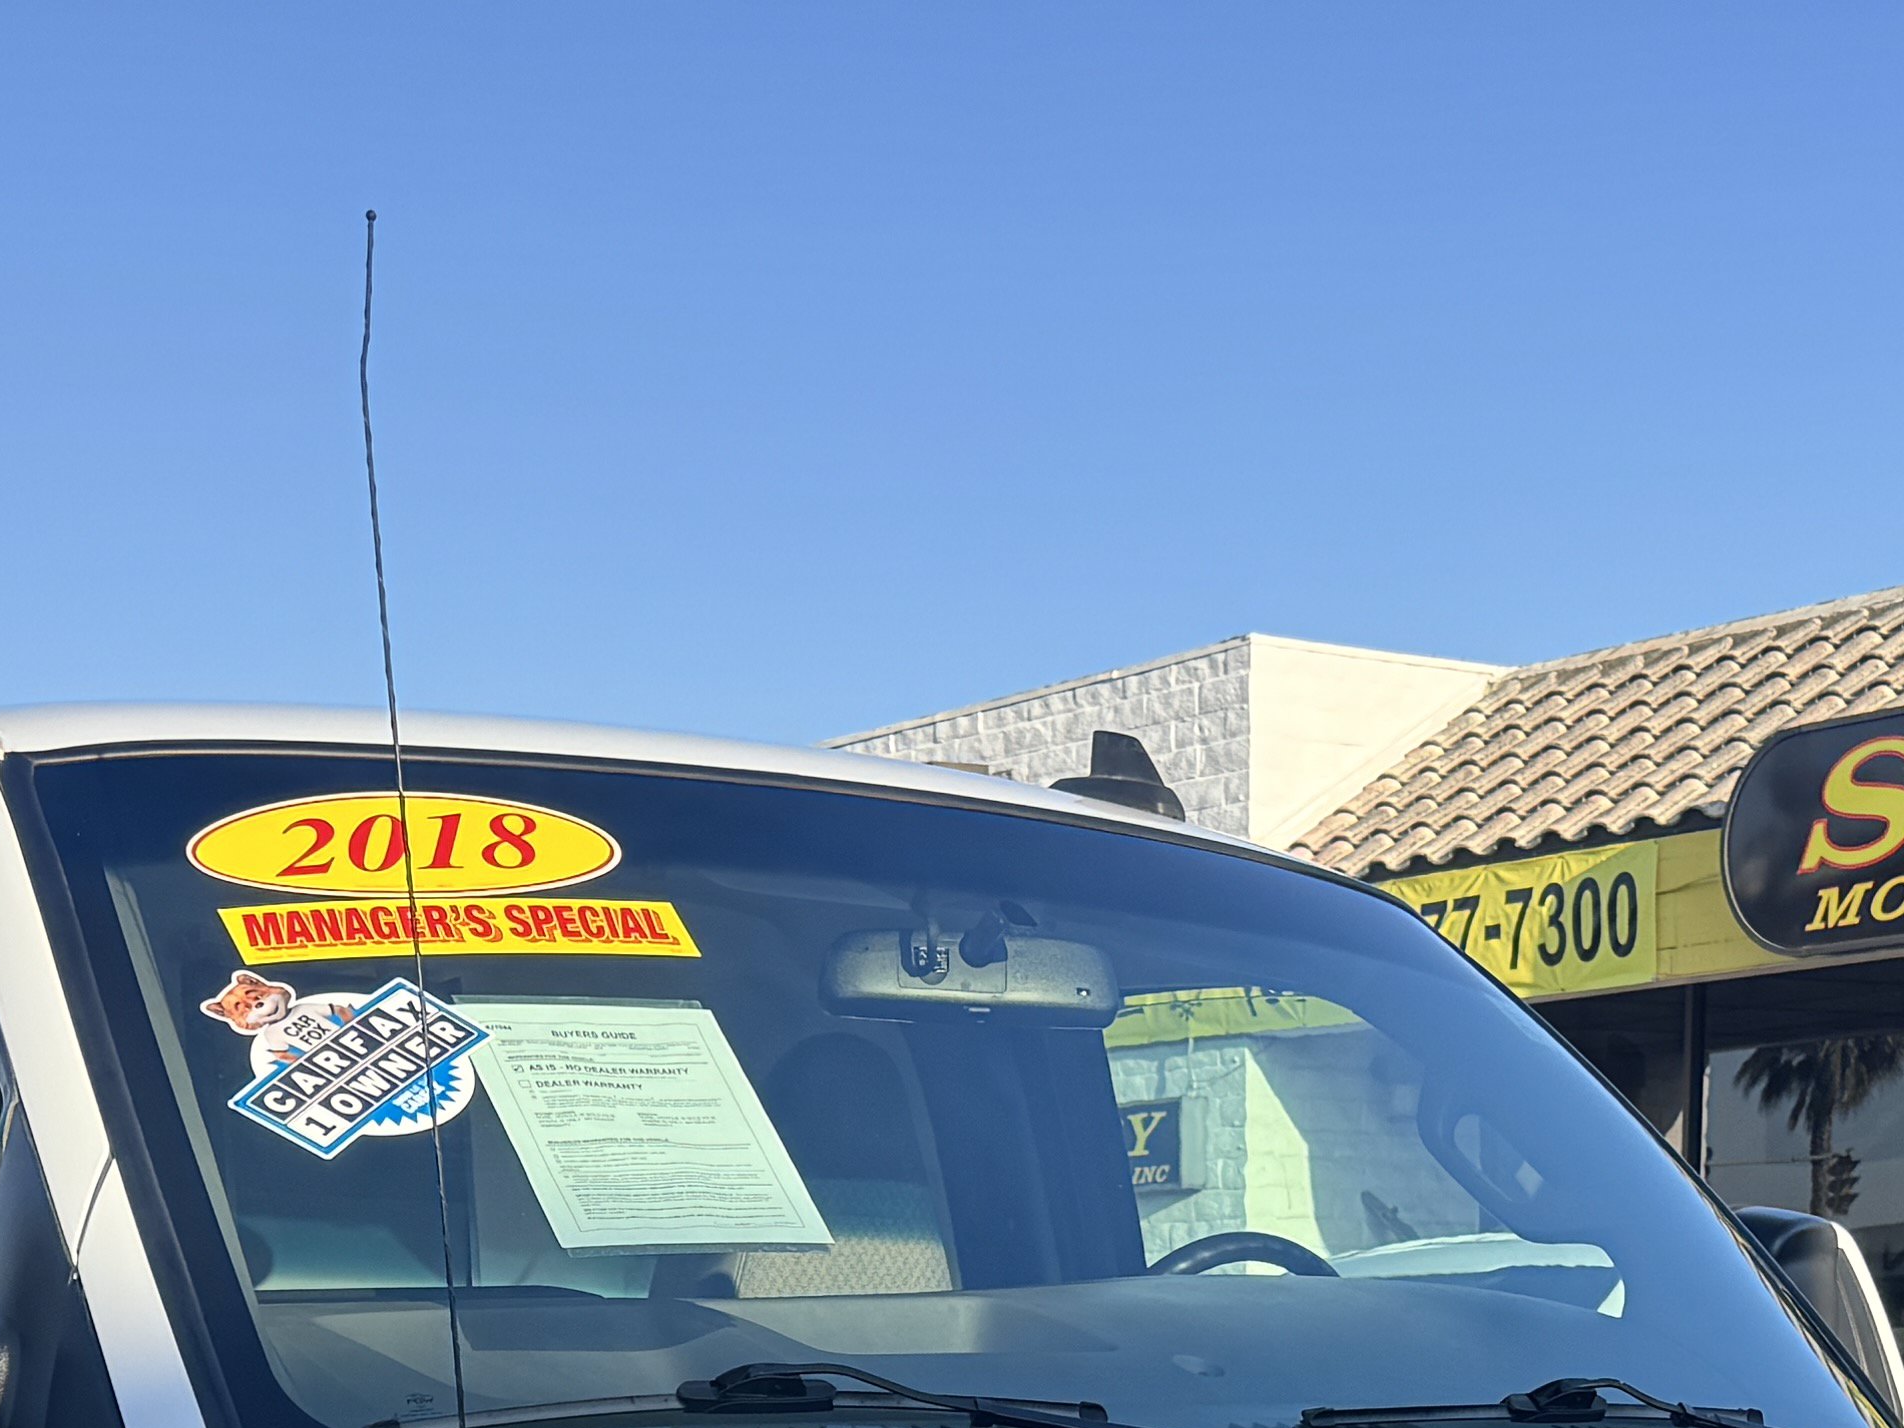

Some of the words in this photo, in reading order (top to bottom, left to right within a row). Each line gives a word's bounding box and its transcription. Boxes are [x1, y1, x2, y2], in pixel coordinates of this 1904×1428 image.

[276, 811, 537, 878] 2018
[242, 902, 502, 949] MANAGER'S
[504, 904, 680, 945] SPECIAL
[283, 1014, 316, 1037] CAR
[300, 1024, 332, 1046] FOX
[551, 1030, 597, 1039] BUYERS
[601, 1031, 637, 1040] GUIDE
[263, 1000, 431, 1113] CARFAX
[305, 1116, 337, 1137] 1
[330, 1020, 466, 1118] OWNER
[535, 1080, 580, 1088] DEALER
[1132, 1164, 1170, 1184] INC
